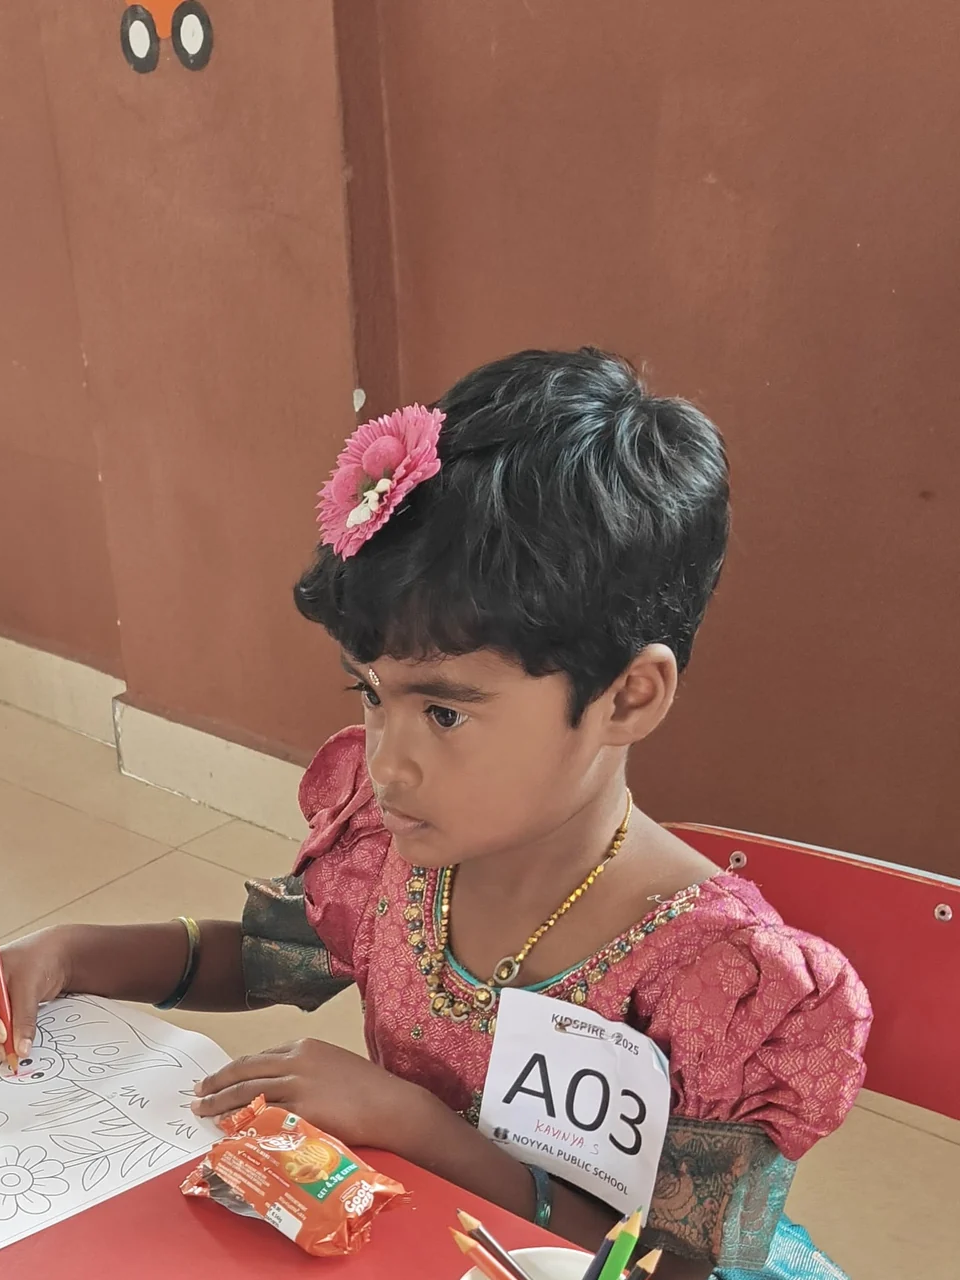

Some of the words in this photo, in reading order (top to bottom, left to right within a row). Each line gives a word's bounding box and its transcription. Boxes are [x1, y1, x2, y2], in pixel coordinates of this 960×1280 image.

[551, 1013, 606, 1040] KIDSPIRE
[502, 1053, 647, 1156] A03
[512, 1133, 554, 1156] NOYYAL
[556, 1149, 592, 1172] PUBLIC
[592, 1167, 629, 1196] SCHOOL
[344, 1179, 372, 1213] Good
